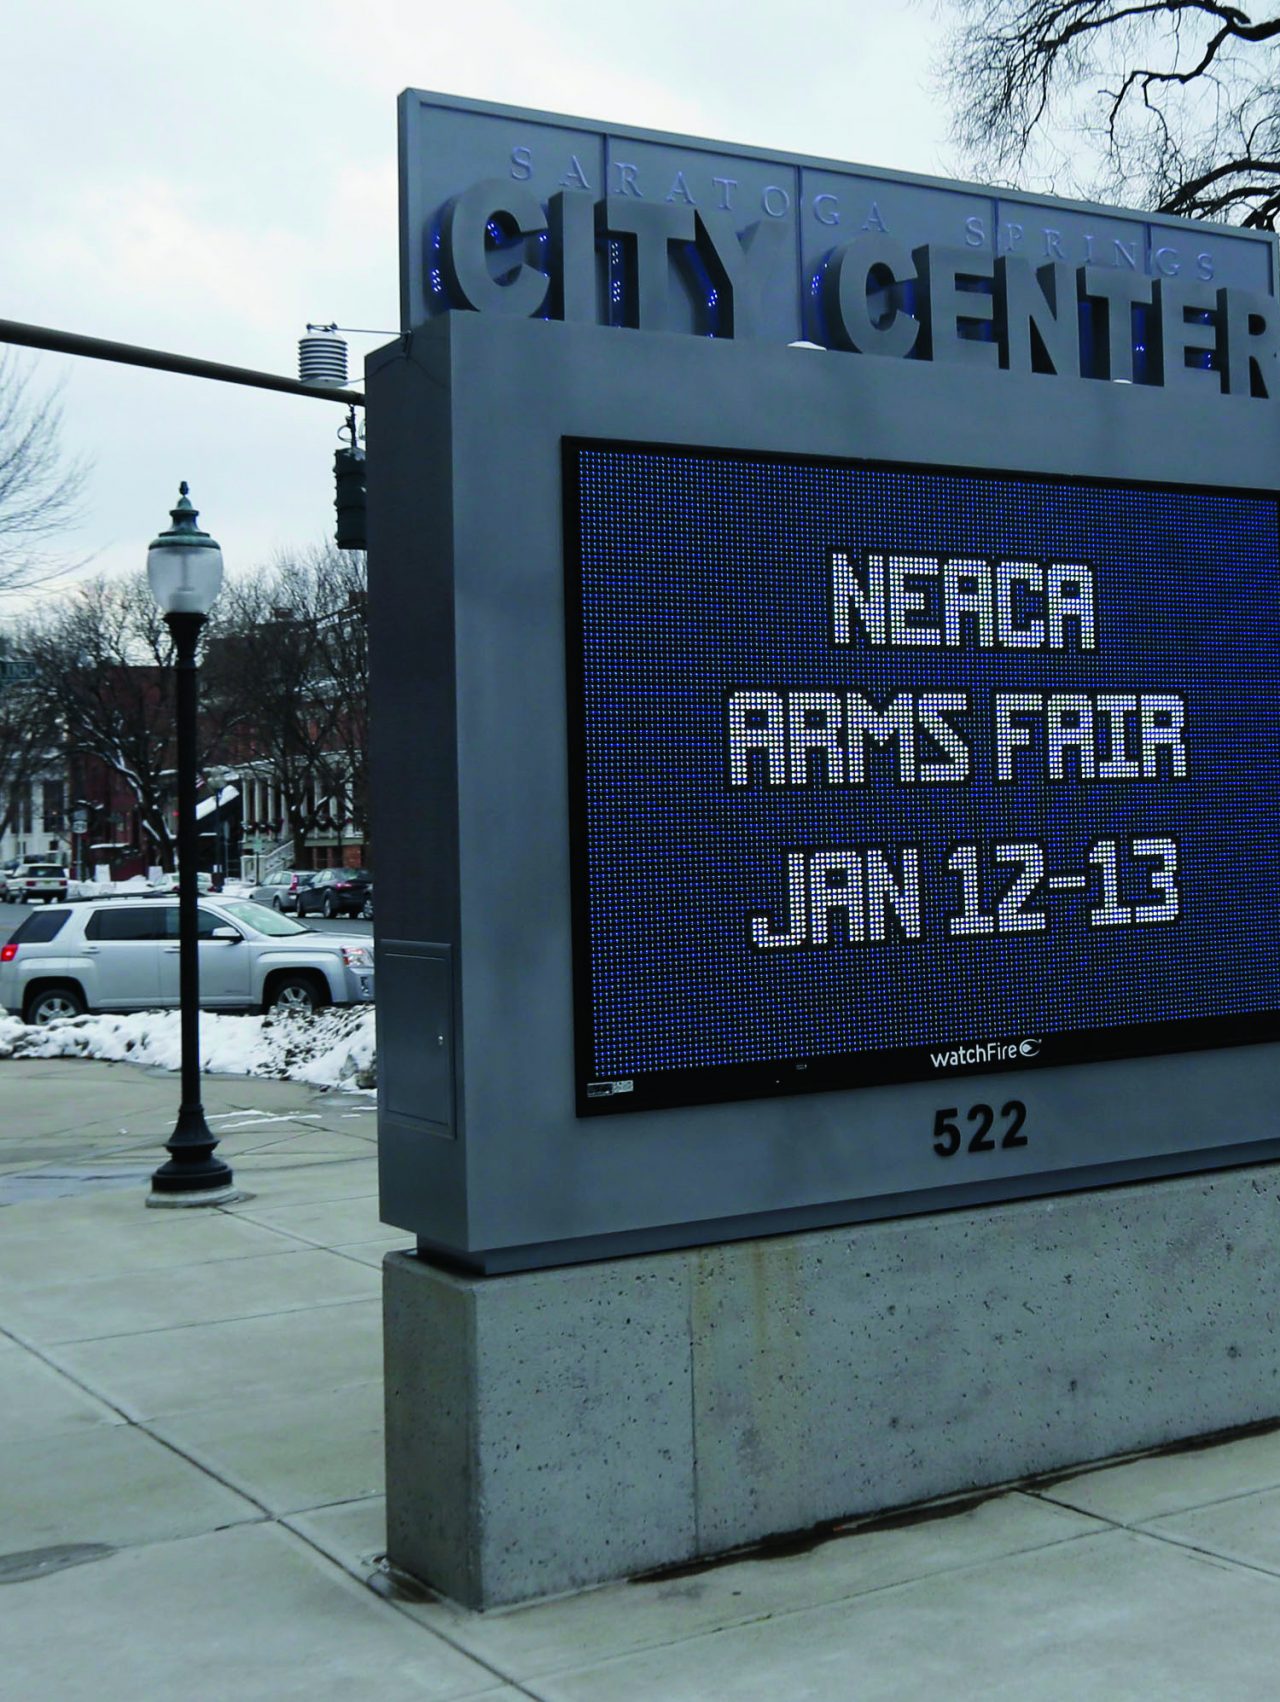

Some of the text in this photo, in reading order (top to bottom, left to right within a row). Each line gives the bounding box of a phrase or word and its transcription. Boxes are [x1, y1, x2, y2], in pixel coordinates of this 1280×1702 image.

[450, 178, 794, 339] CITY
[510, 146, 1215, 281] SARATOGA SPRINGS
[831, 553, 1096, 649] NEACA
[728, 691, 1187, 786] ARMS FAIR
[751, 838, 1180, 948] JAN 12-13
[930, 1042, 1018, 1068] watchFire
[933, 1099, 1029, 1158] 522
